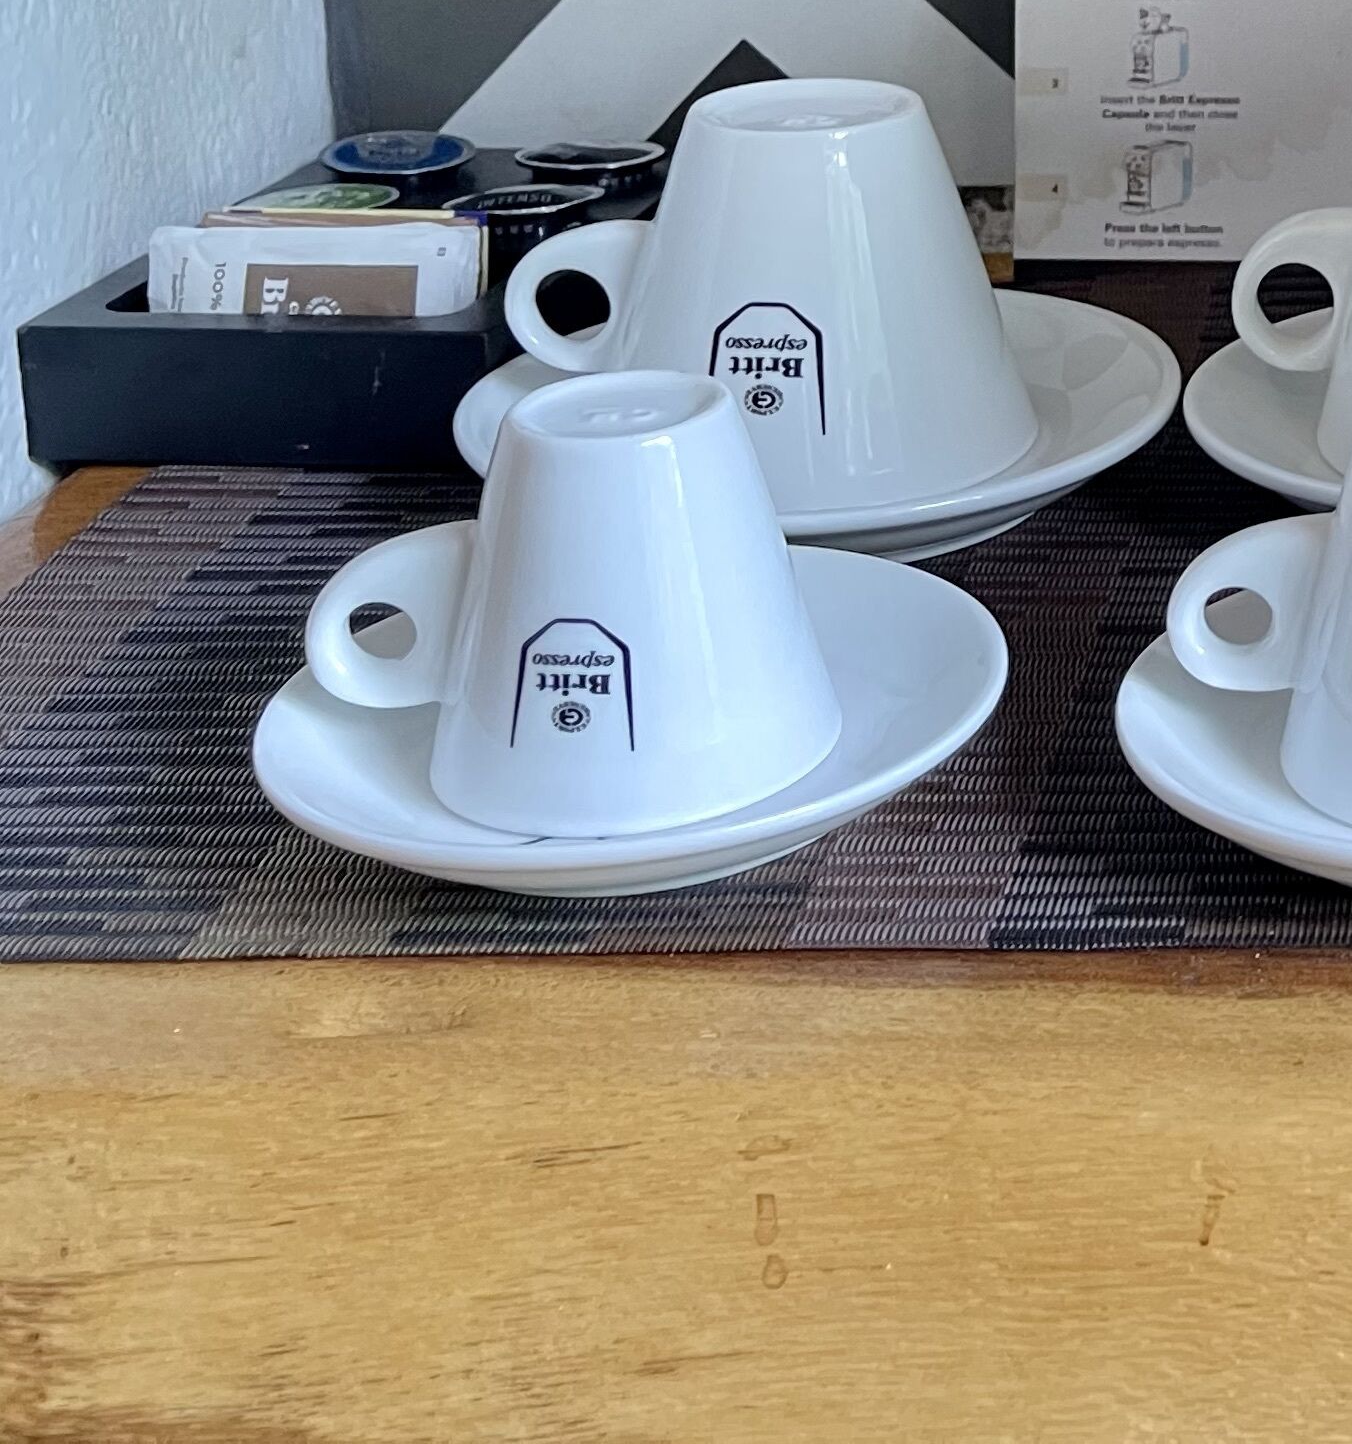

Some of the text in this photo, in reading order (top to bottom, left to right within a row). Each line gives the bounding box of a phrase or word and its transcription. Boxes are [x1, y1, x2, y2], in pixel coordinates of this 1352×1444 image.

[1102, 108, 1150, 120] Capsule
[1104, 223, 1136, 233] Press
[209, 261, 227, 311] 100%
[725, 333, 808, 352] espresso
[728, 355, 805, 380] Britt
[531, 650, 616, 669] espresso
[535, 672, 612, 697] Britt
